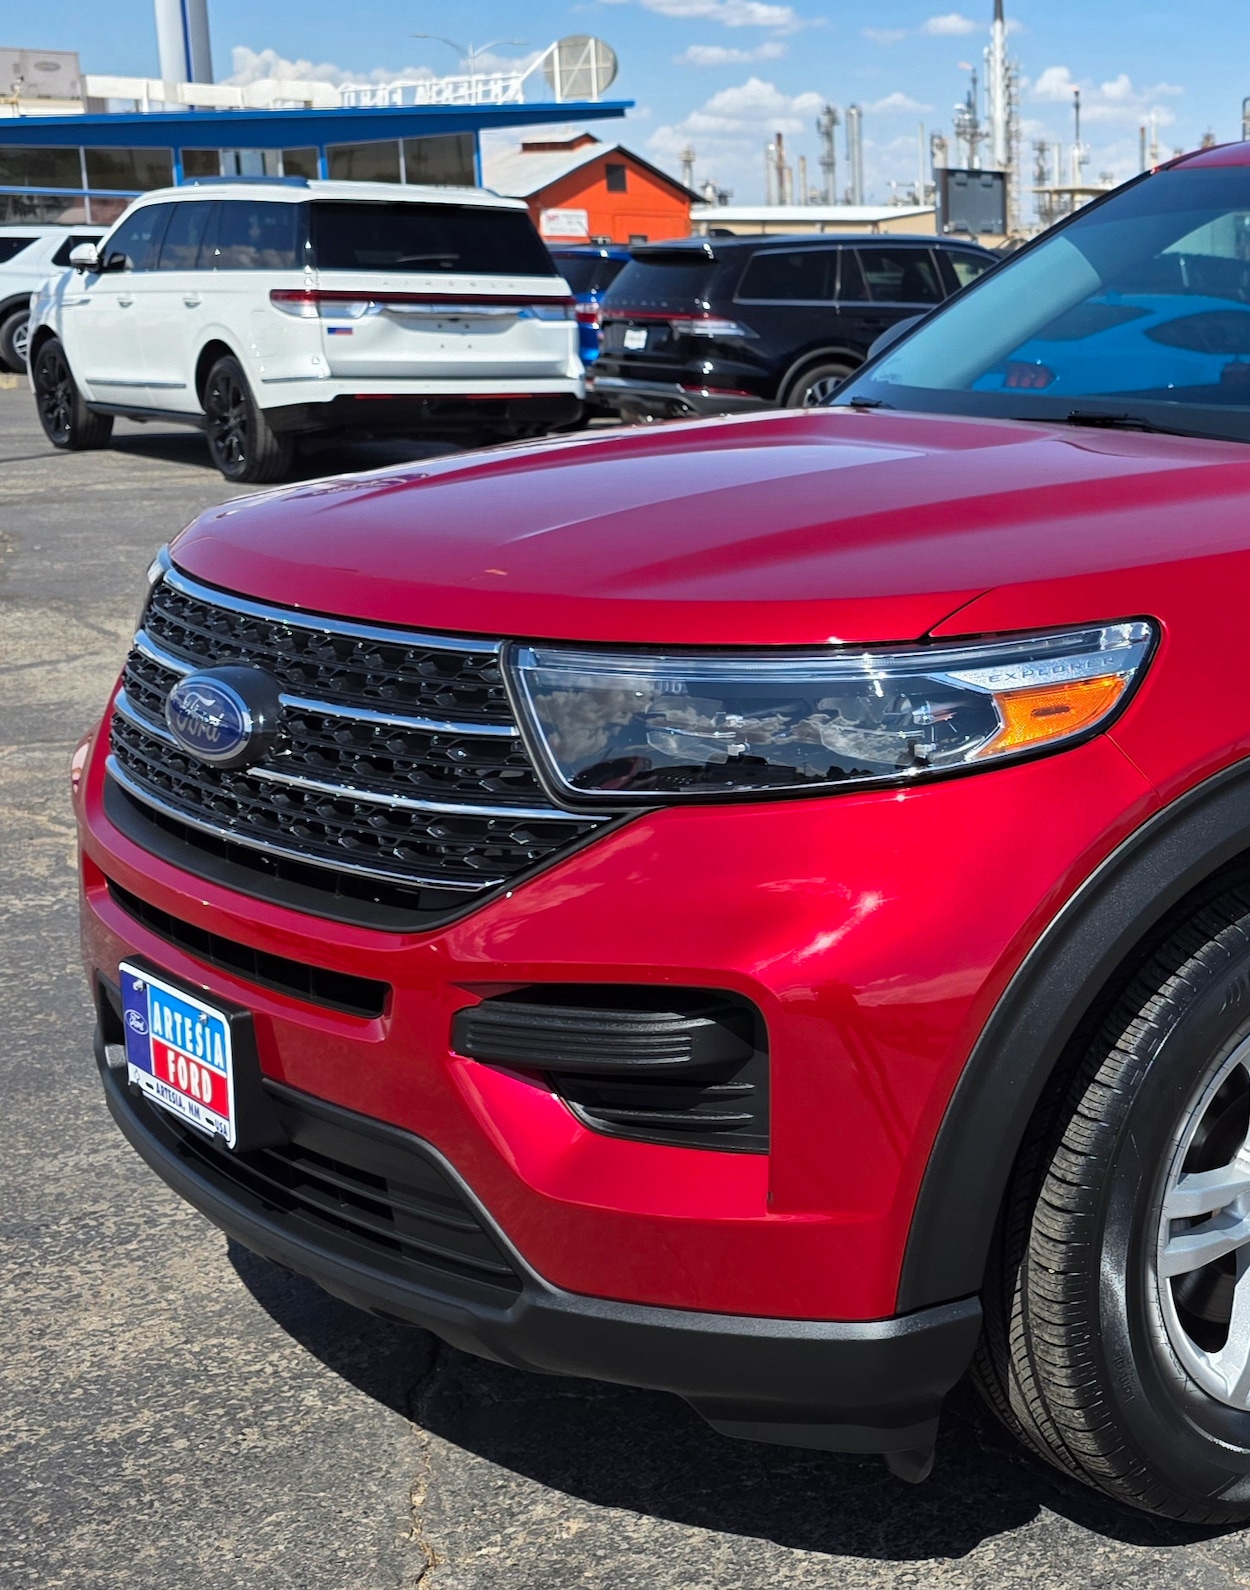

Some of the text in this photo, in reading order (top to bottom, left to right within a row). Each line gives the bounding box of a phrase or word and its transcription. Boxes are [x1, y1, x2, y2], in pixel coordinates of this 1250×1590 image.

[988, 655, 1116, 684] EXPLORER
[152, 1000, 225, 1069] ARTESIA
[156, 1082, 186, 1112] ARTESIA,
[166, 1049, 213, 1104] FORD
